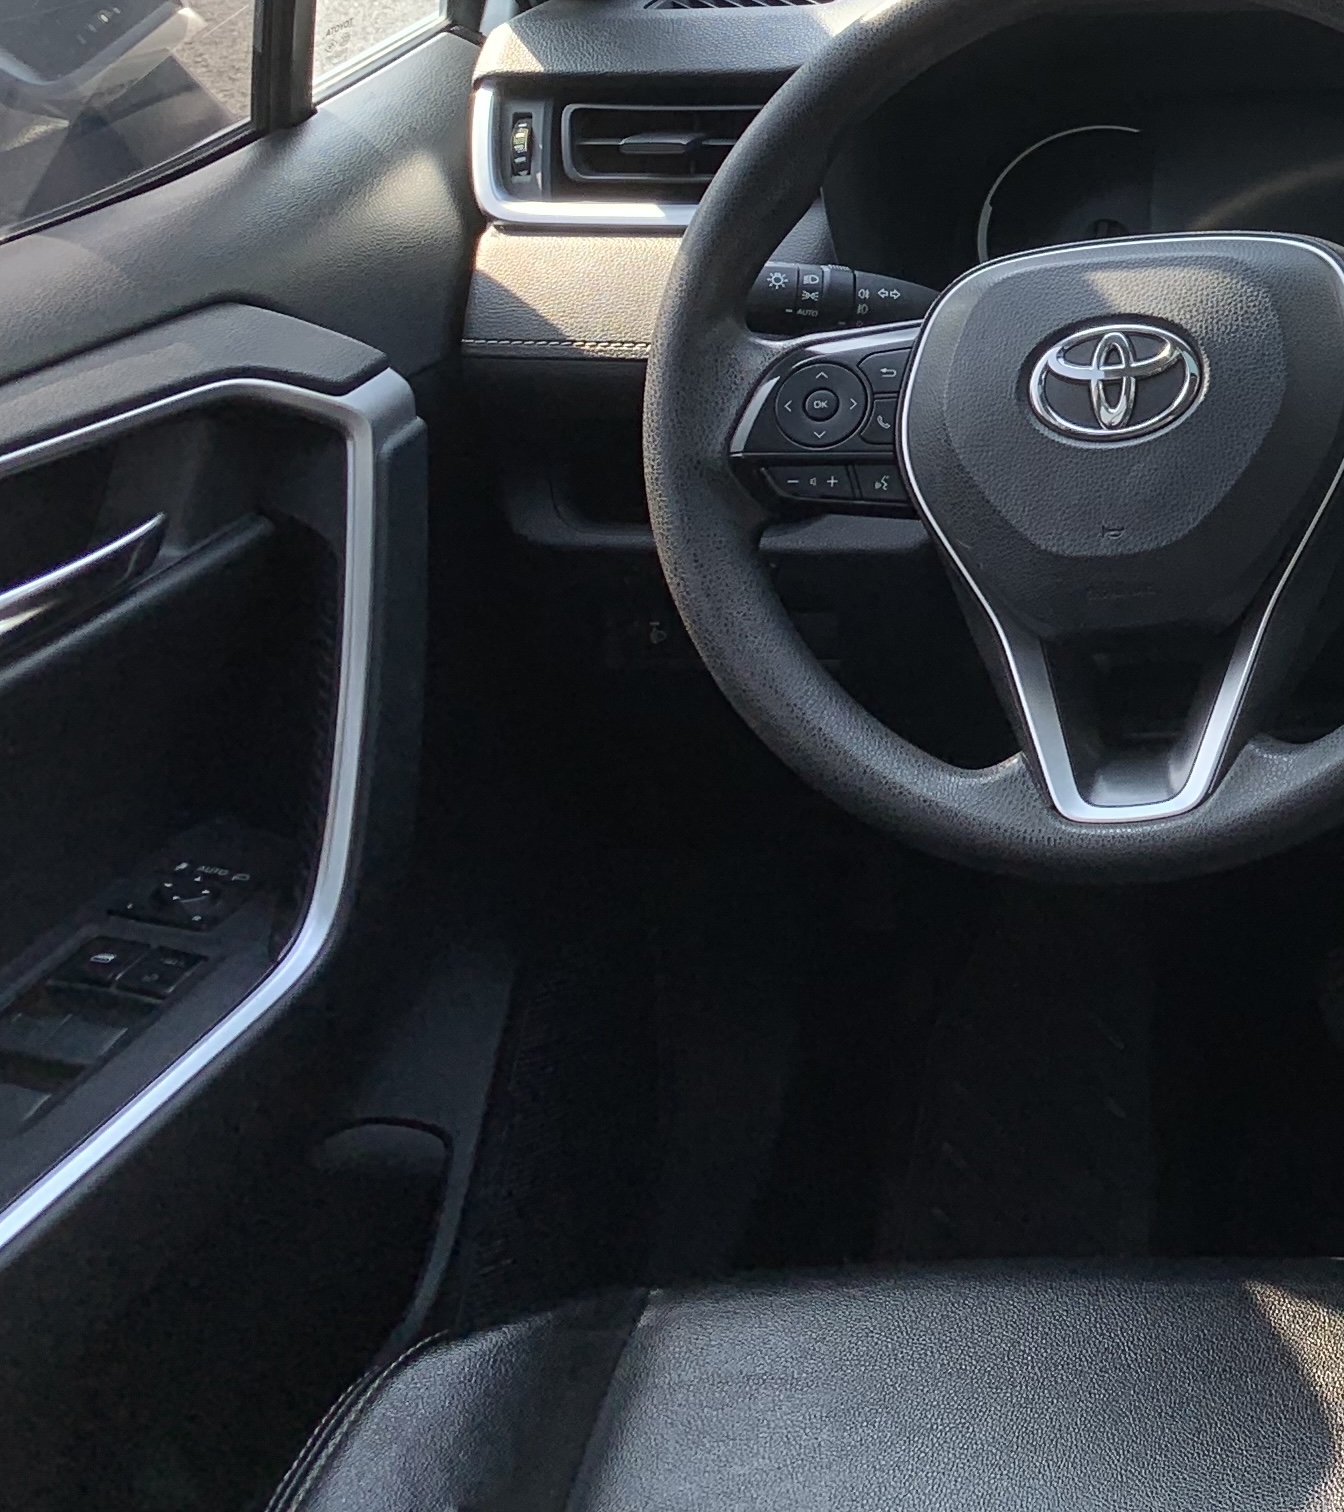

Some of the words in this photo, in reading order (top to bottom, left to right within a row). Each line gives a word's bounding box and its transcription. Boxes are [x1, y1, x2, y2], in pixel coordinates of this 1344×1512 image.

[796, 308, 819, 317] AUTO
[813, 400, 828, 409] OK
[196, 865, 229, 877] AUTO
